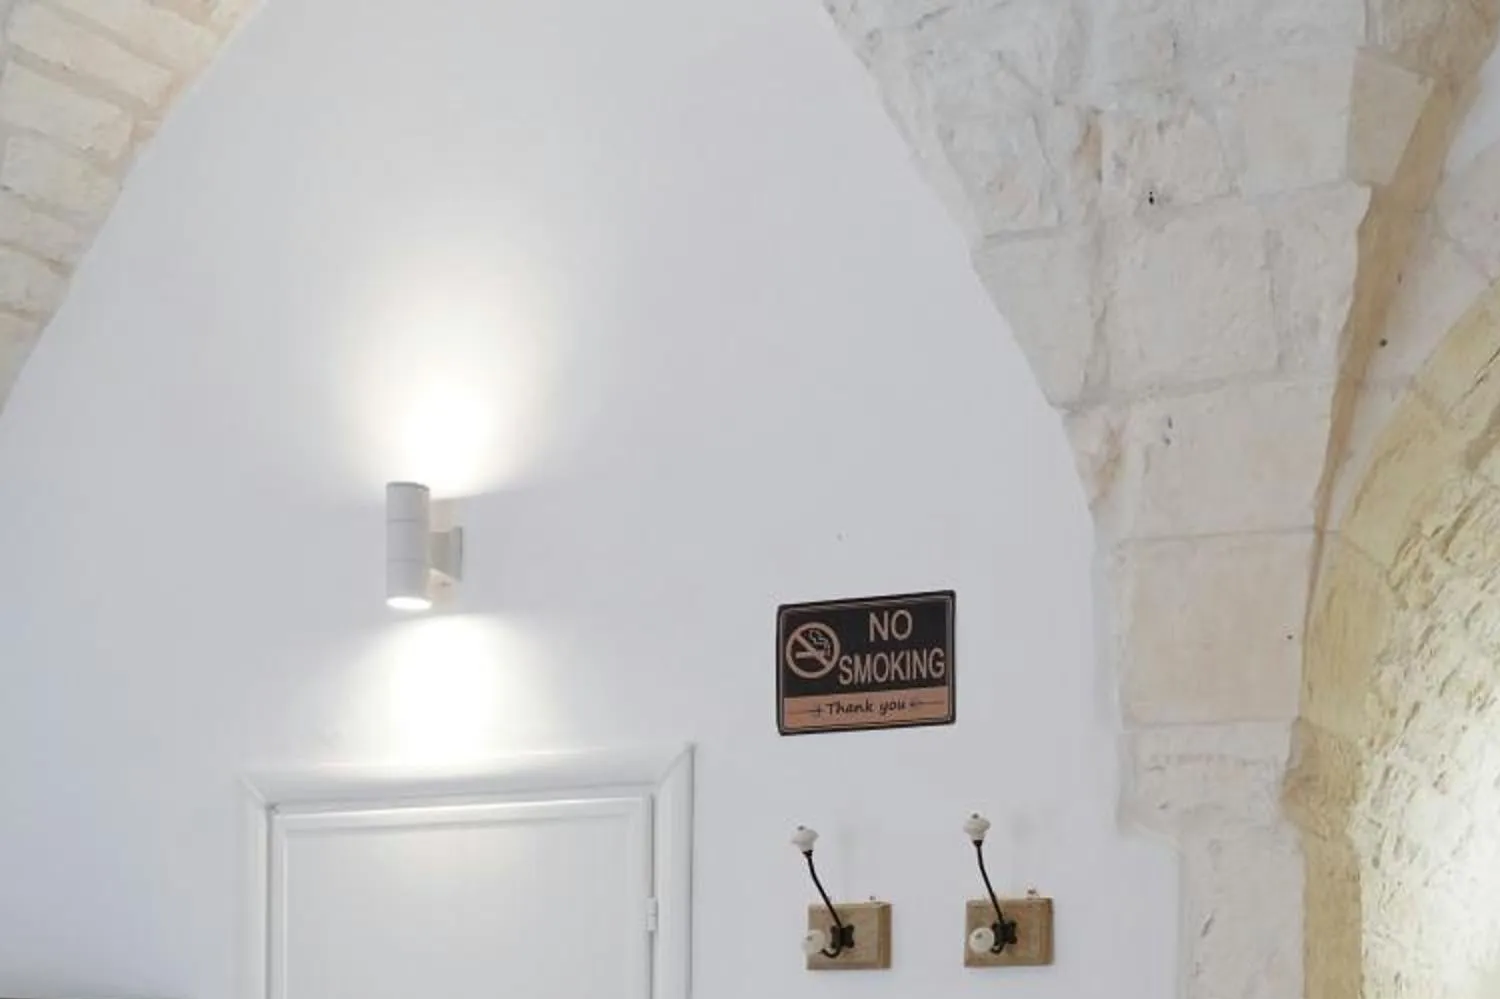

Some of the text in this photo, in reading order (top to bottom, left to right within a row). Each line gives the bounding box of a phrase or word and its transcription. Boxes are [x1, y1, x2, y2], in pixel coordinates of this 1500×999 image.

[869, 610, 913, 642] NO
[839, 647, 945, 685] SMOKING
[827, 699, 905, 716] Thank you
